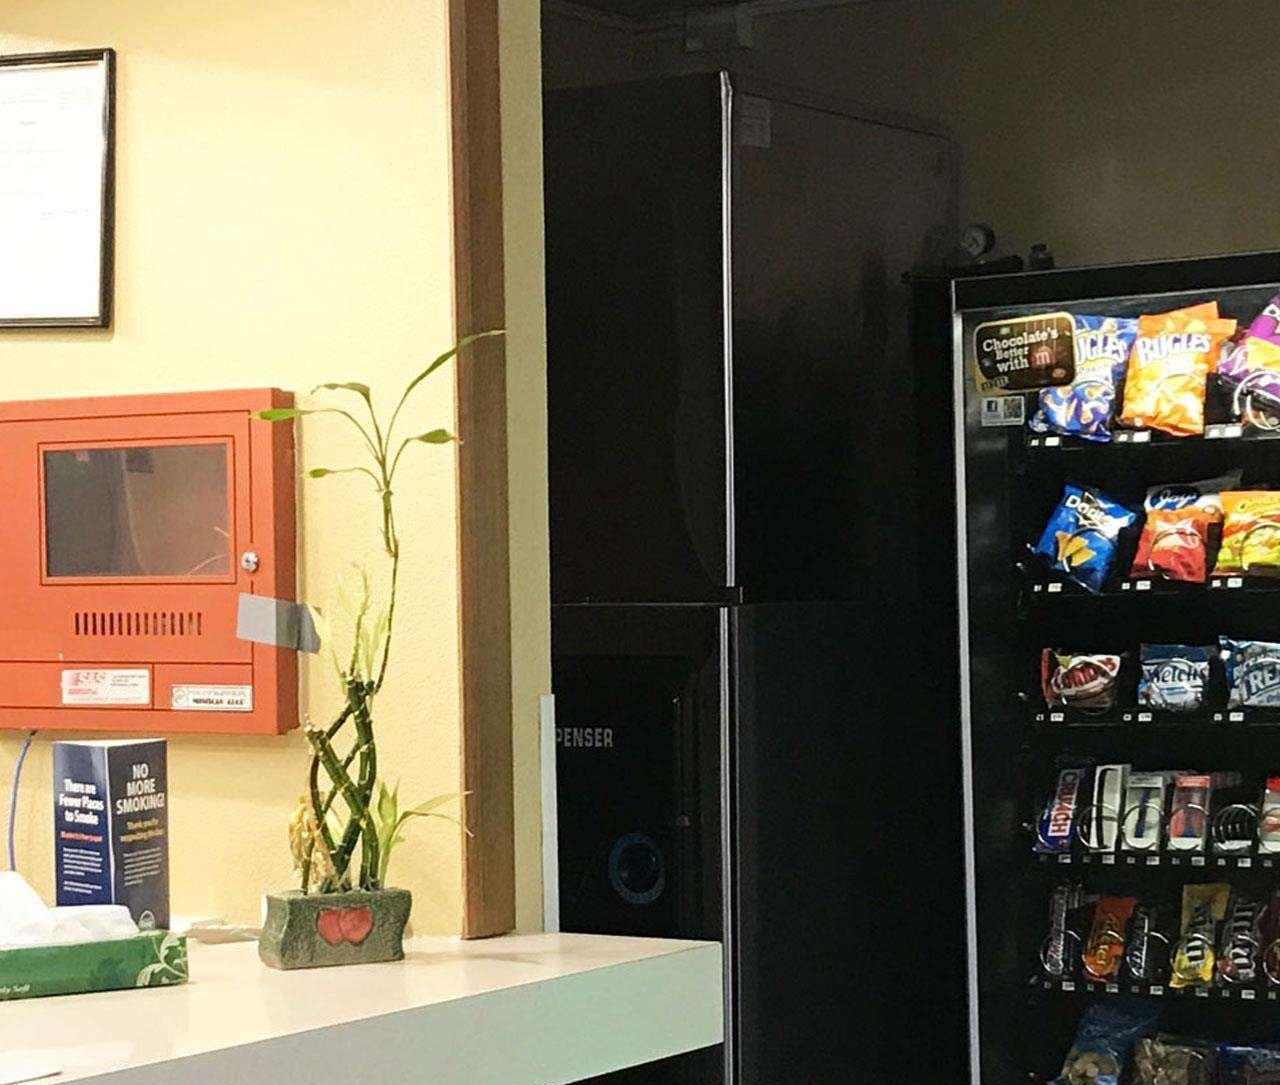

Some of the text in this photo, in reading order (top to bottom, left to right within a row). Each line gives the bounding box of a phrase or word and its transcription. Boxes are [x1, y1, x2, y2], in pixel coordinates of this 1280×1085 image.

[982, 327, 1059, 352] Chocolate's
[1135, 333, 1212, 367] BUGLES
[996, 357, 1030, 373] with
[132, 763, 149, 779] NO
[126, 778, 156, 796] MORE
